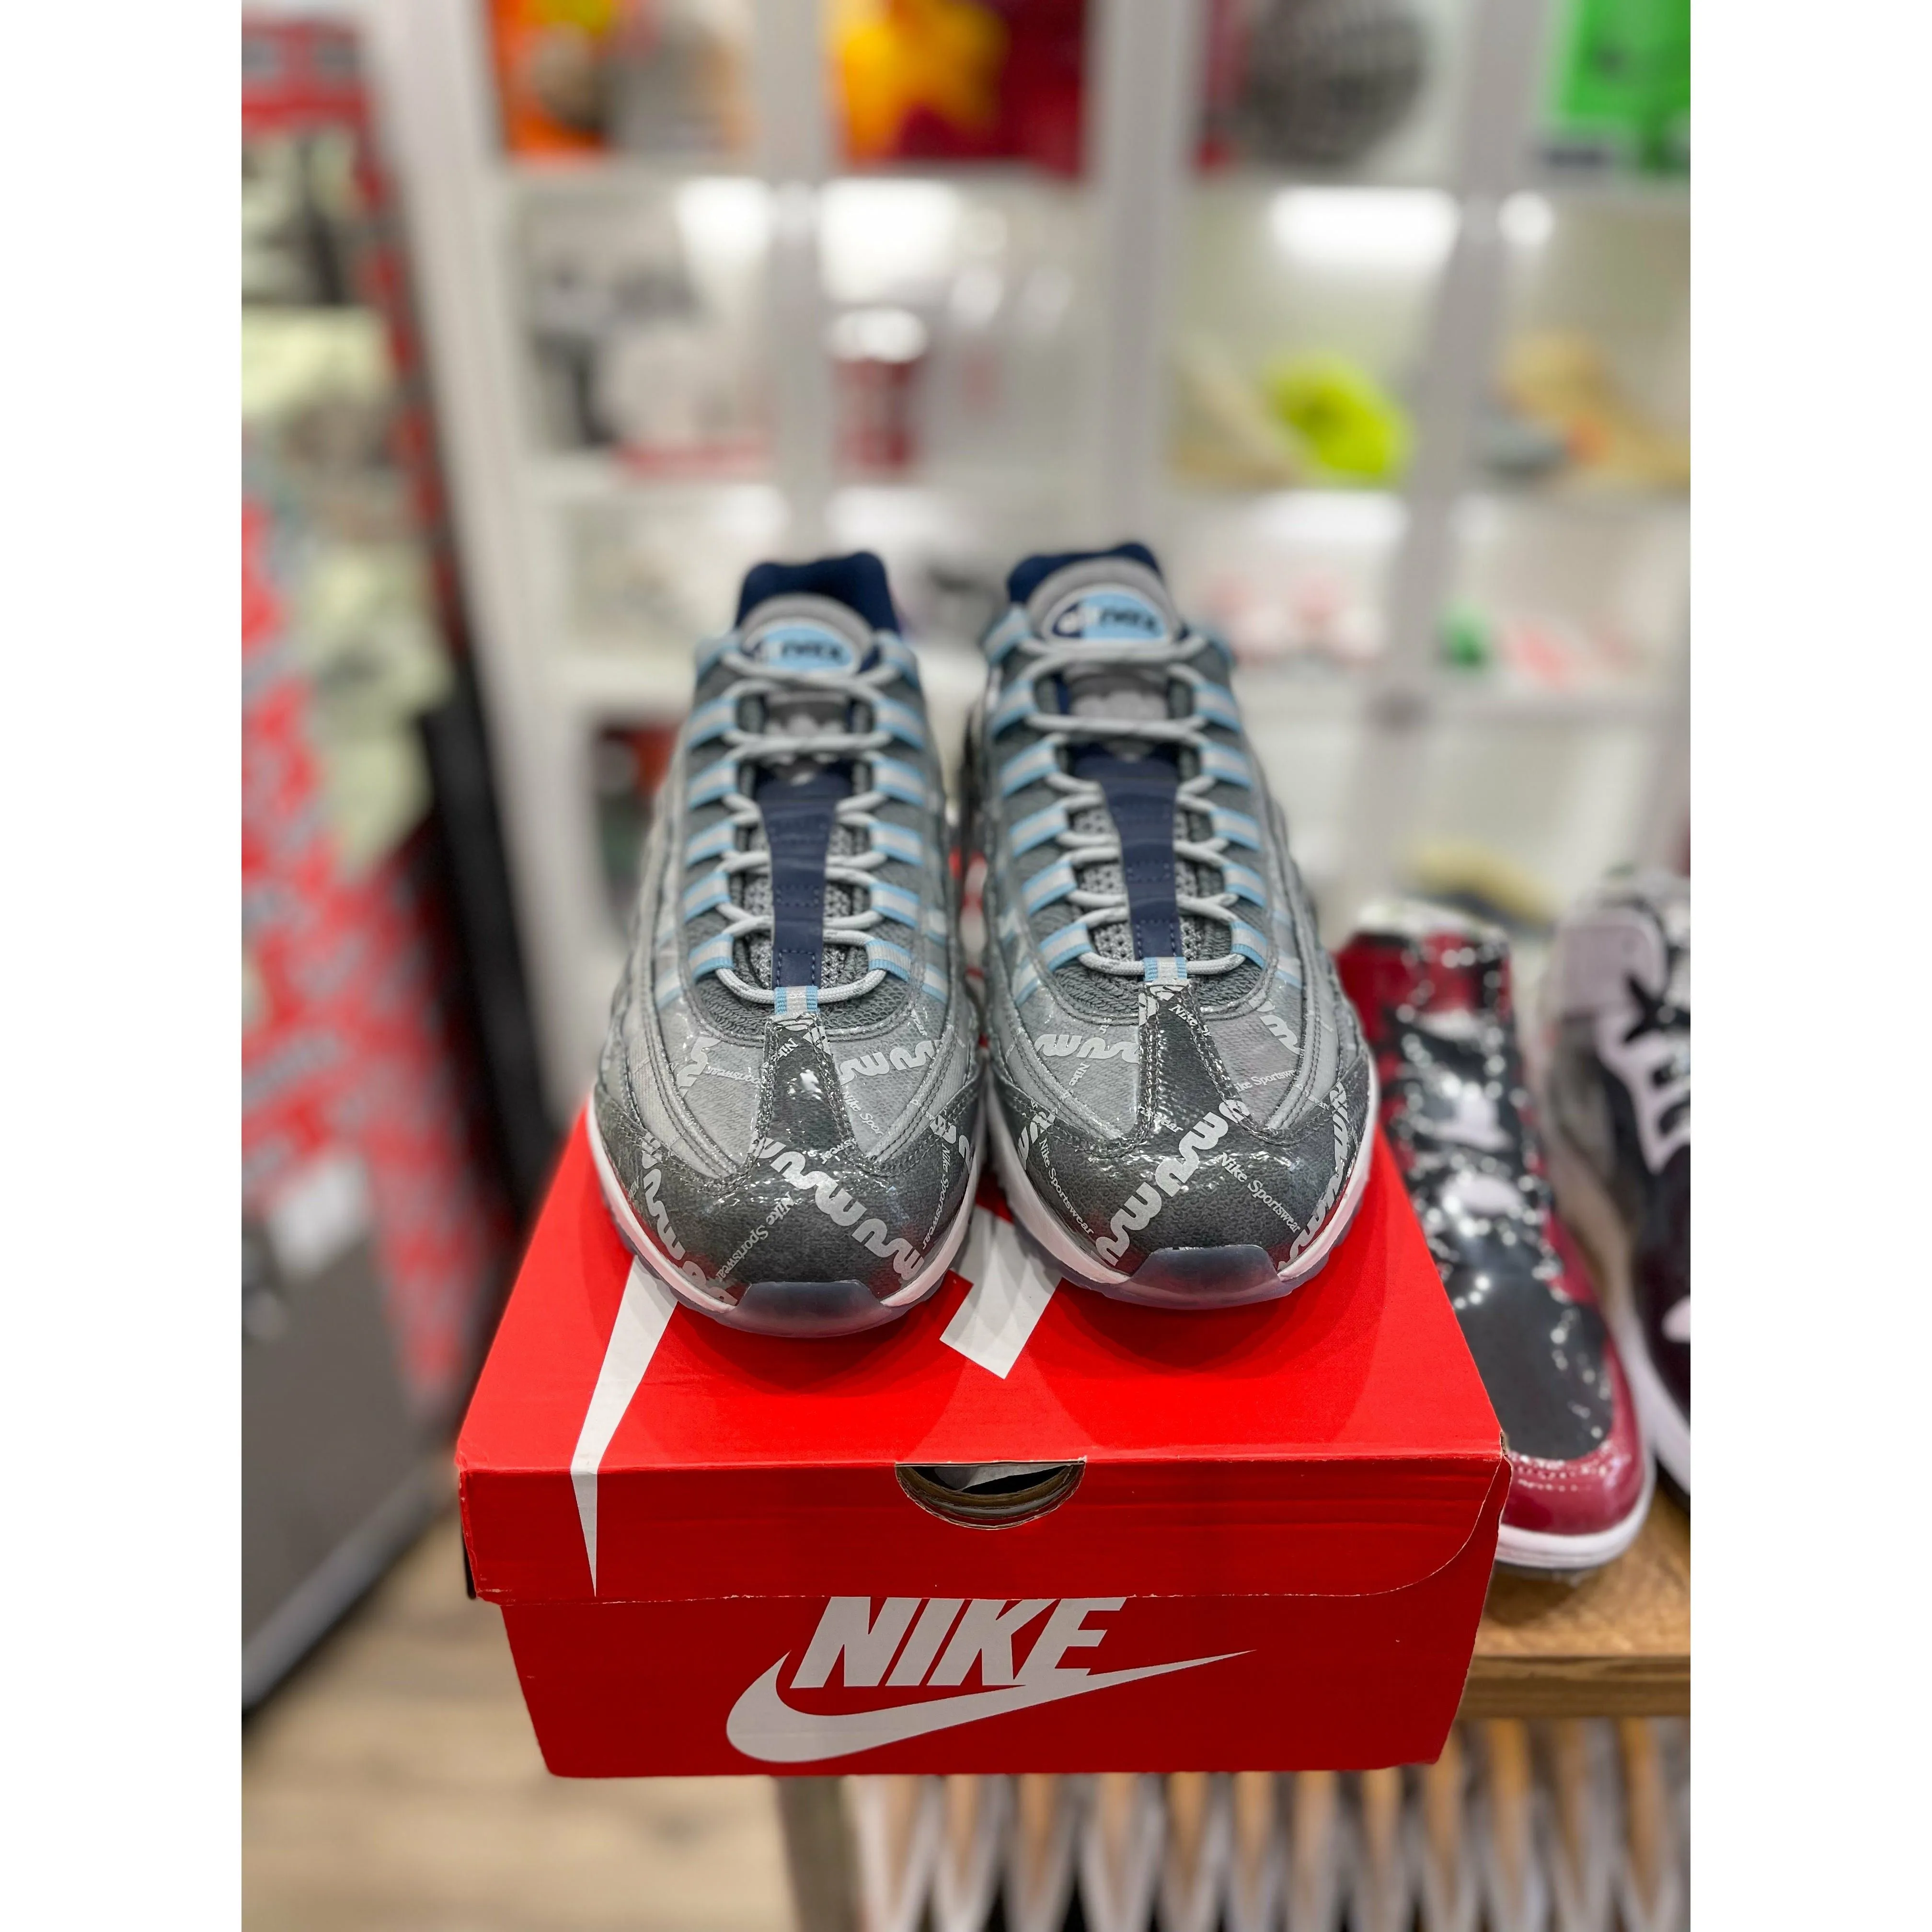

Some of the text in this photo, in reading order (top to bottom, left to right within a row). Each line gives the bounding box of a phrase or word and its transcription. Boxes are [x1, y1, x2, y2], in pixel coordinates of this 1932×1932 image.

[770, 1037, 799, 1062] Nike
[1069, 1062, 1091, 1087] Nike
[1233, 1069, 1295, 1092] ike Sportswe
[842, 1090, 862, 1112] Nike
[922, 1143, 951, 1250] Nike Sportswear
[1039, 1138, 1094, 1235] Nike Sportswear
[1221, 1152, 1301, 1233] Nike Sportswear
[715, 1191, 795, 1282] Nike Sportswear
[790, 1596, 1127, 1689] NIKE
